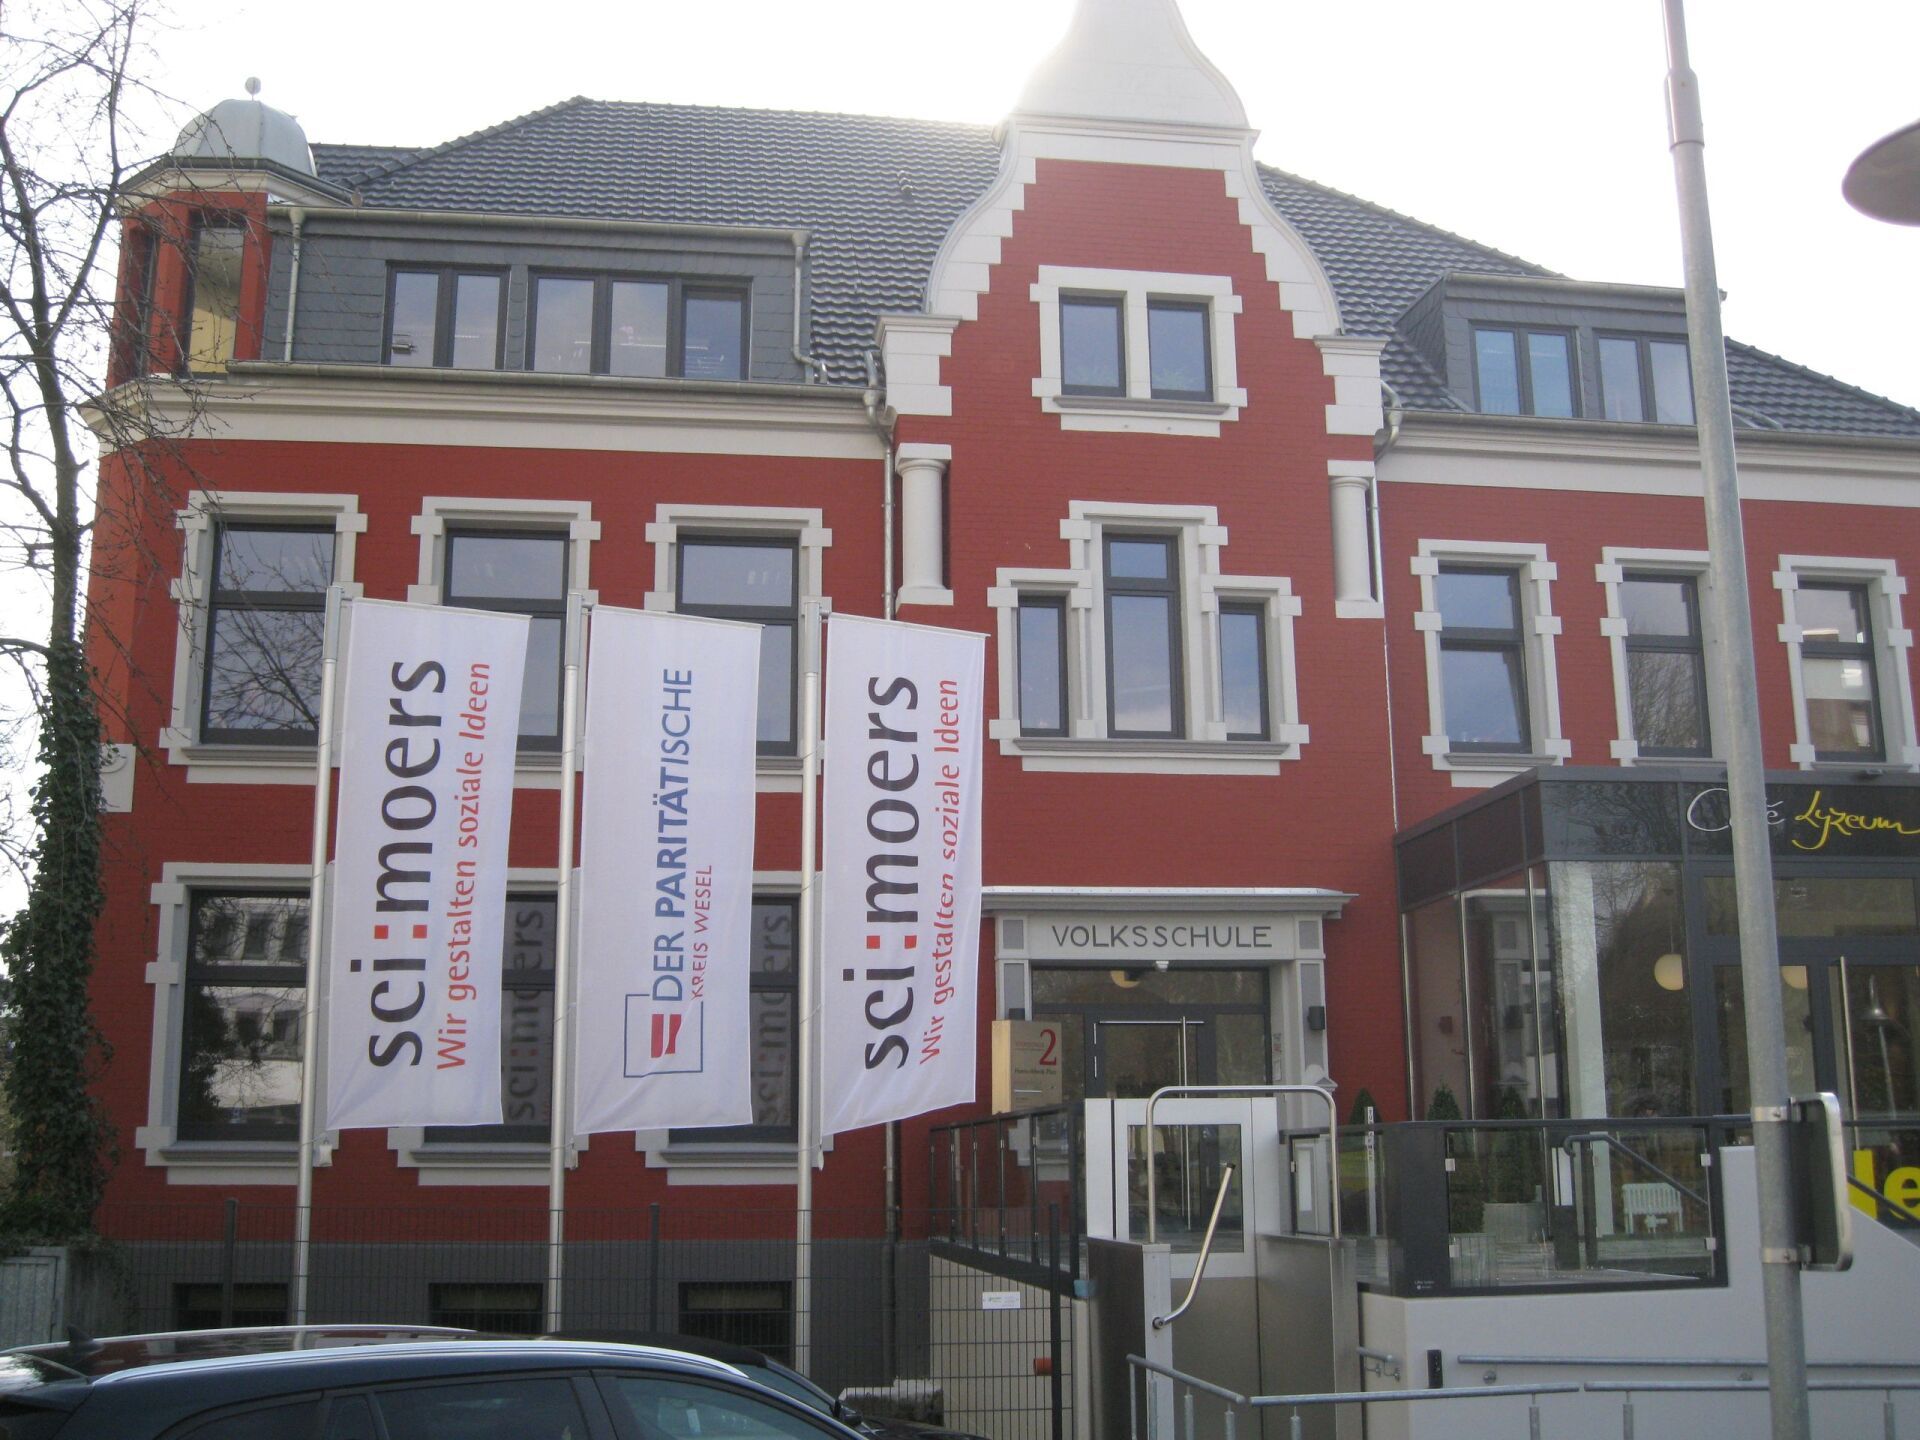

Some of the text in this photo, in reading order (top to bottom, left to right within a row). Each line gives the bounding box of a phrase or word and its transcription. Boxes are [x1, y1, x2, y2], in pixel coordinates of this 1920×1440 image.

[350, 660, 446, 1067] sci:moers
[437, 662, 490, 1071] Wir gestalten soziale Ideen
[652, 668, 693, 1002] DER PARITÄTISCHE
[692, 865, 712, 1001] KREIS WESEL
[842, 676, 921, 1070] sci:moers
[919, 679, 961, 1065] Wir gestalten soziale Ideen
[1051, 924, 1273, 949] VOLKSSCHULE
[1792, 790, 1920, 850] Lyzeum
[1039, 1028, 1057, 1066] 2
